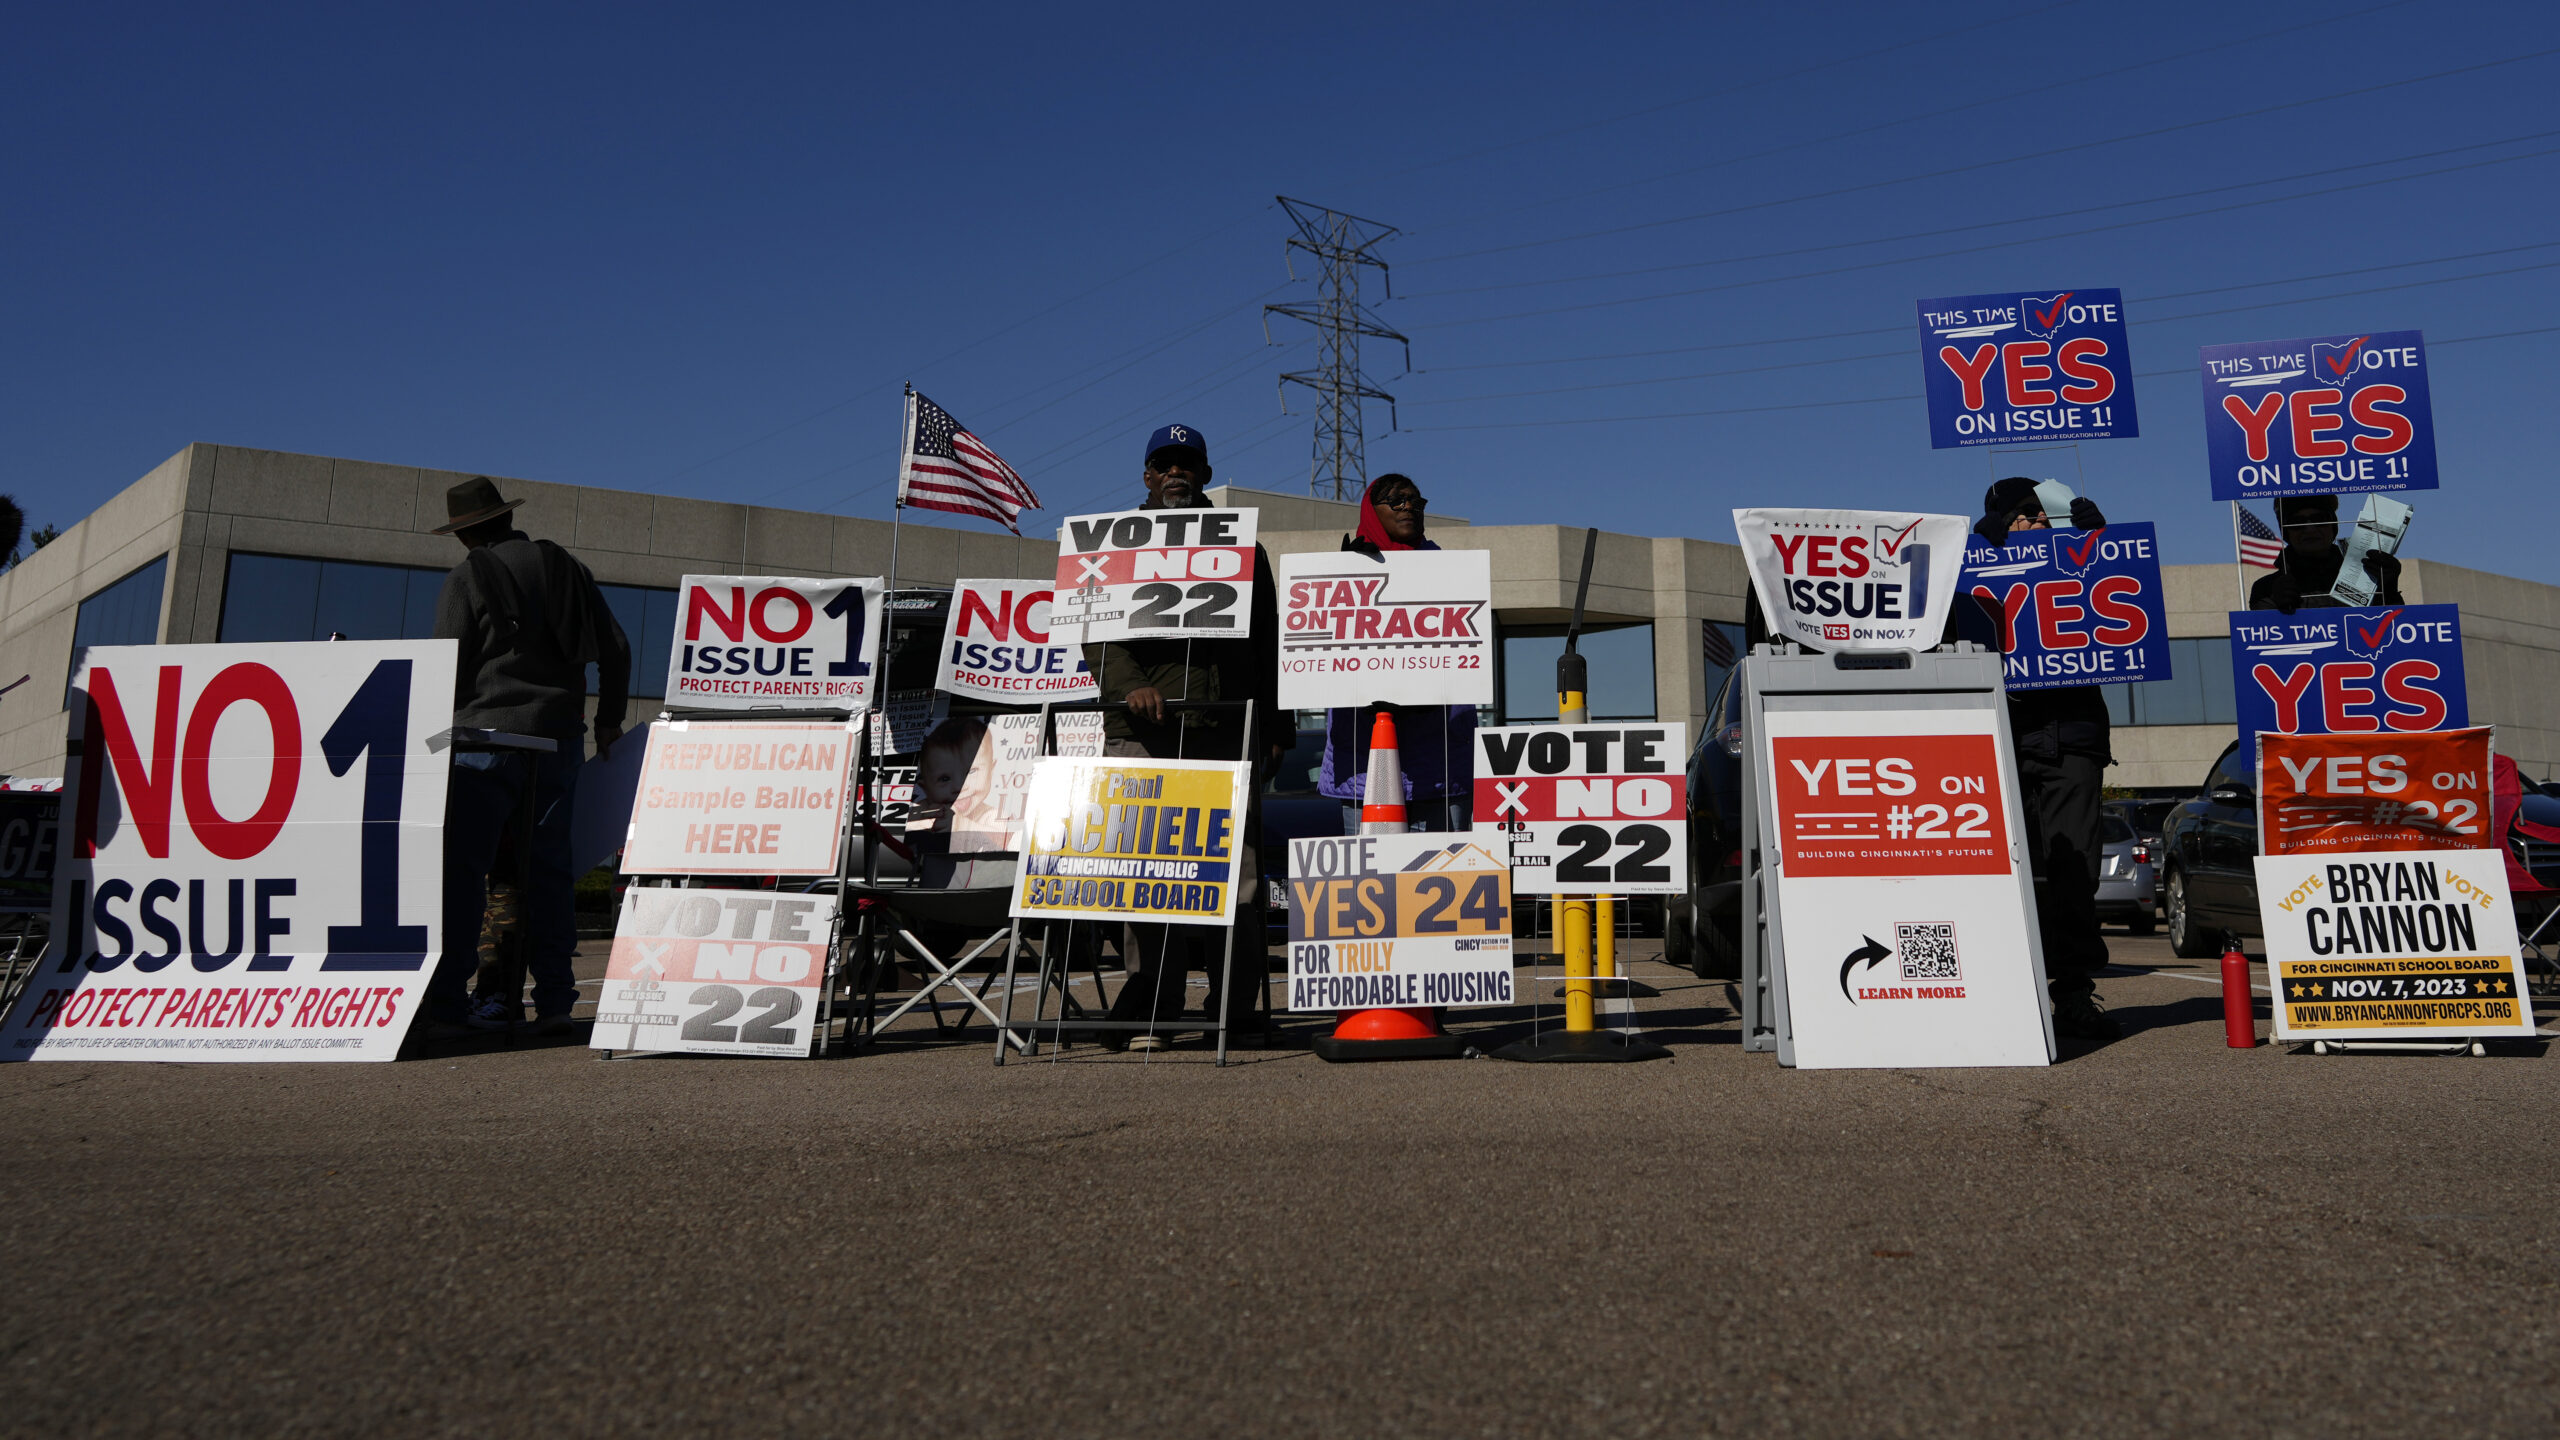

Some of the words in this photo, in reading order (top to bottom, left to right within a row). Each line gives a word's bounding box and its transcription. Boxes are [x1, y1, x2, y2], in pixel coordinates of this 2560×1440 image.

[1924, 310, 1967, 327] THIS
[1972, 307, 2017, 324] TIME
[1940, 337, 2116, 411] YES
[2207, 358, 2252, 376] THIS
[2258, 354, 2306, 372] TIME
[1170, 426, 1187, 442] KC
[1955, 413, 1996, 434] ON
[2004, 408, 2083, 431] ISSUE
[2091, 406, 2113, 427] 1!
[2222, 384, 2413, 462] YES
[2238, 464, 2281, 486] ON
[2291, 459, 2375, 484] ISSUE
[2385, 457, 2409, 479] 1!
[1069, 513, 1239, 553] VOTE
[1133, 549, 1242, 580] NO
[1770, 533, 1870, 578] YES
[1871, 571, 1887, 579] ON
[2003, 544, 2048, 561] TIME
[1287, 579, 1380, 609] STAY
[1783, 578, 1902, 620] ISSUE
[1900, 543, 1931, 620] 1
[1070, 596, 1083, 604] ON
[1084, 594, 1109, 603] ISSUE
[1128, 582, 1238, 629] 22
[1971, 575, 2149, 654] YES
[685, 586, 813, 643] NO
[822, 586, 871, 676] 1
[1052, 615, 1074, 625] SAVE
[1077, 613, 1097, 623] OUR
[1099, 611, 1121, 621] RAIL
[1286, 610, 1328, 631] ON
[1330, 607, 1472, 640] TRACK
[1795, 620, 1821, 636] VOTE
[1824, 625, 1849, 639] YES
[1853, 628, 1872, 639] ON
[1876, 629, 1905, 640] NOV.
[1908, 628, 1916, 639] 7
[2236, 625, 2284, 643] THIS
[2289, 623, 2338, 640] TIME
[681, 645, 814, 676] ISSUE
[951, 640, 1068, 674] ISSUE
[1282, 658, 1326, 673] VOTE
[1332, 657, 1361, 672] NO
[1367, 656, 1394, 671] ON
[1402, 655, 1451, 670] ISSUE
[1458, 654, 1480, 669] 22
[2037, 650, 2115, 676] ISSUE
[2124, 648, 2146, 671] 1!
[680, 677, 750, 694] PROTECT
[753, 680, 823, 696] PARENTS'
[955, 670, 1033, 691] PROTECT
[2252, 659, 2447, 733] YES
[659, 742, 837, 771] REPUBLICAN
[1481, 730, 1665, 776] VOTE
[1107, 773, 1163, 799] Paul
[1789, 757, 1917, 796] YES
[1940, 775, 1985, 795] ON
[2278, 754, 2408, 794] YES
[2431, 771, 2477, 790] ON
[647, 786, 746, 814] Sample
[755, 785, 834, 810] Ballot
[1556, 778, 1672, 818] NO
[73, 661, 302, 860] NO
[319, 659, 428, 971] 1
[1034, 802, 1232, 857] SCHIELE
[1886, 803, 1992, 840] #22
[2372, 798, 2479, 835] #22
[685, 823, 781, 854] HERE
[1556, 824, 1672, 882] 22
[1798, 851, 1856, 859] BUILDING
[1860, 849, 1943, 858] CINCINNATI'S
[1948, 848, 1994, 857] FUTURE
[2279, 838, 2337, 849] BUILDING
[2342, 833, 2424, 844] CINCINNATI'S
[2430, 835, 2478, 850] FUTURE
[1058, 859, 1142, 878] CINCINNATI
[1144, 861, 1199, 880] PUBLIC
[1295, 838, 1377, 877] VOTE
[1524, 856, 1547, 866] RAIL
[1029, 878, 1126, 908] SCHOOL
[1133, 882, 1220, 912] BOARD
[2277, 874, 2324, 913] VOTE
[2326, 861, 2440, 904] BRYAN
[2444, 868, 2494, 910] VOTE
[632, 894, 816, 942] VOTE
[1294, 878, 1386, 938] YES
[1414, 875, 1508, 933] 24
[56, 878, 296, 973] ISSUE
[1499, 937, 1509, 945] FOR
[2306, 903, 2477, 956] CANNON
[1294, 945, 1330, 975] FOR
[1336, 942, 1394, 974] TRULY
[1455, 938, 1480, 951] CINCY
[693, 943, 812, 983] NO
[2292, 964, 2320, 975] FOR
[2322, 962, 2396, 974] CINCINNATI
[2398, 960, 2453, 973] SCHOOL
[2455, 959, 2500, 971] BOARD
[620, 991, 634, 1001] ON
[636, 991, 664, 1001] ISSUE
[1294, 974, 1417, 1008] AFFORDABLE
[1424, 971, 1511, 1004] HOUSING
[1858, 987, 1913, 1000] LEARN
[1917, 986, 1966, 1000] MORE
[2331, 980, 2386, 998] NOV.
[2391, 979, 2408, 999] 7,
[2413, 978, 2467, 996] 2023
[25, 987, 167, 1028] PROTECT
[160, 986, 302, 1028] PARENTS'
[291, 986, 404, 1028] RIGHTS
[599, 1013, 625, 1024] SAVE
[627, 1014, 648, 1025] OUR
[650, 1015, 675, 1026] RAIL
[680, 985, 802, 1045] 22
[2295, 1002, 2512, 1023] WWW.BRYANCANNONFORCPS.ORG
[56, 1038, 80, 1048] RIGHT
[77, 1038, 89, 1048] TO
[87, 1038, 103, 1048] LIFE
[100, 1038, 114, 1048] OF
[113, 1038, 146, 1049] GREATER
[186, 1038, 204, 1049] NOT
[203, 1038, 249, 1049] AUTHORIZED
[247, 1038, 258, 1049] BY
[257, 1038, 275, 1049] ANY
[273, 1038, 301, 1049] BALLOT
[299, 1038, 321, 1049] ISSUE
